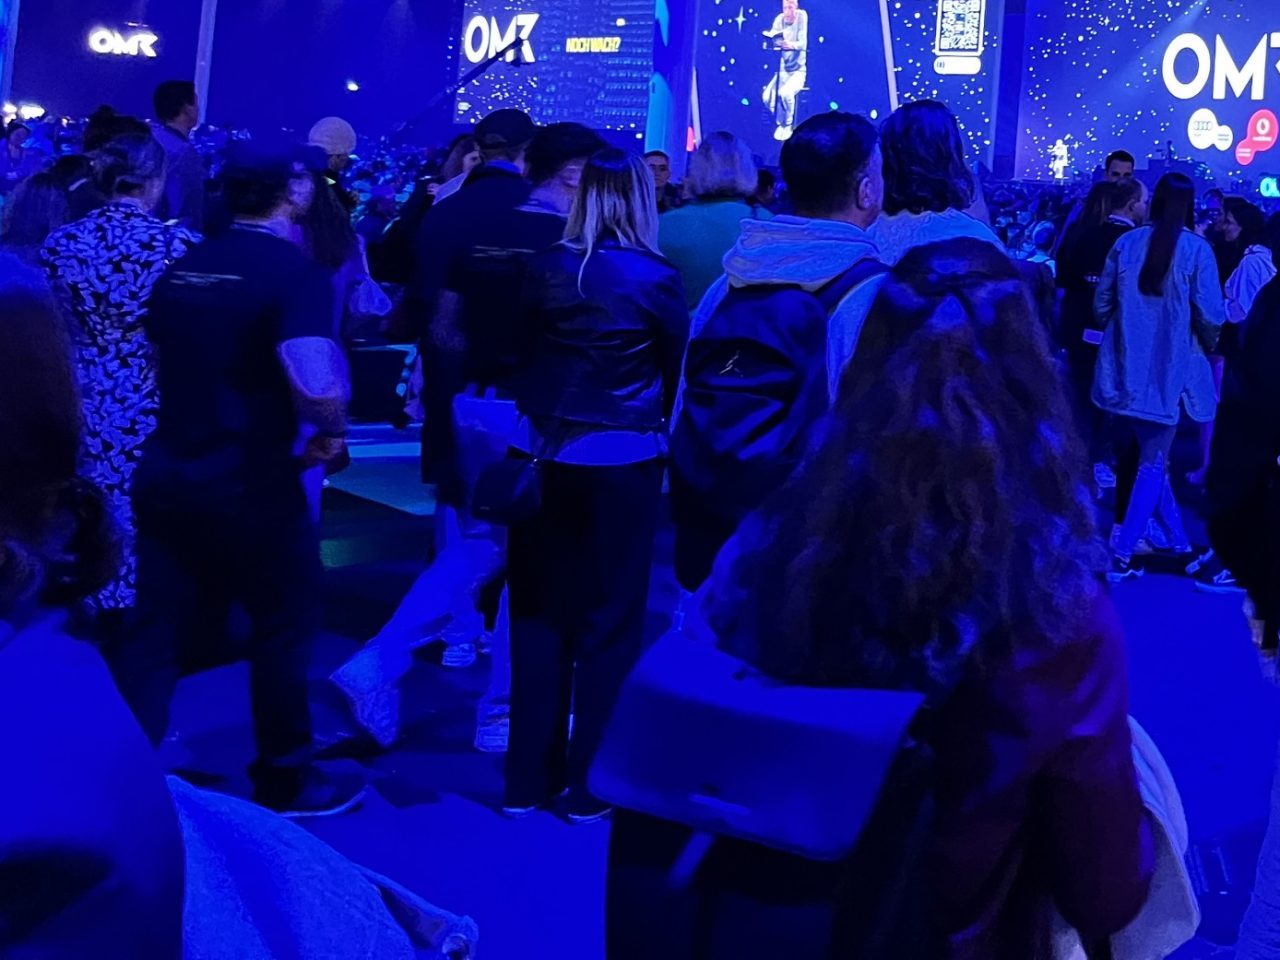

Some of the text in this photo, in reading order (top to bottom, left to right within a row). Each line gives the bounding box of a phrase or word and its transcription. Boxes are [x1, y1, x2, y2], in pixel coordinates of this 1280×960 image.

[89, 29, 158, 57] OMR
[464, 13, 540, 63] OMR
[566, 36, 621, 53] NOCH WACH?
